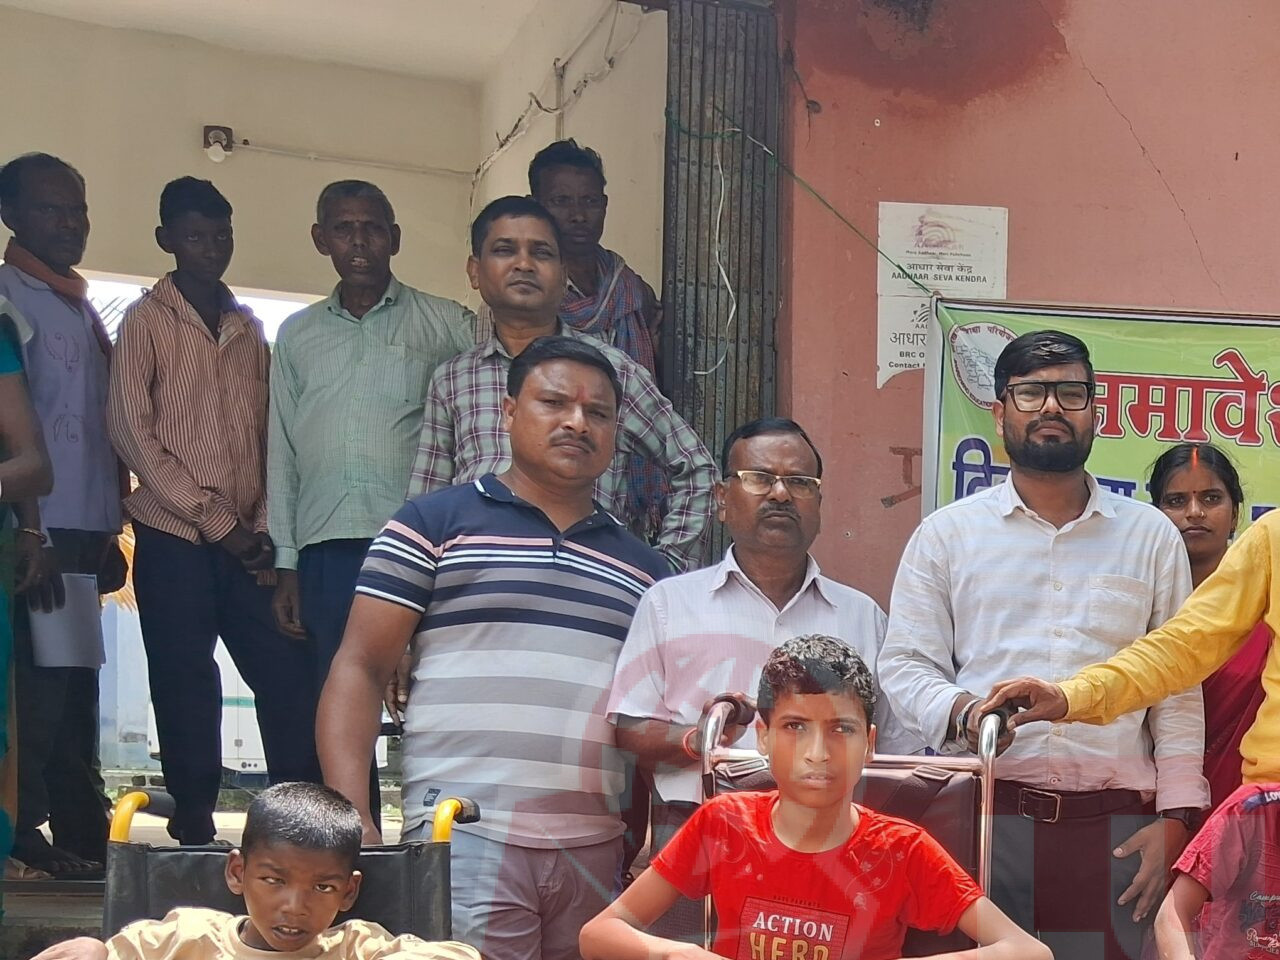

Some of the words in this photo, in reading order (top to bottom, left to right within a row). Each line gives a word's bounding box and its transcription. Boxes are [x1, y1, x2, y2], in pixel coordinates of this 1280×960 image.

[955, 275, 987, 283] KENDRA
[890, 332, 928, 346] आधार
[888, 361, 920, 369] Contact
[753, 912, 833, 942] ACTION
